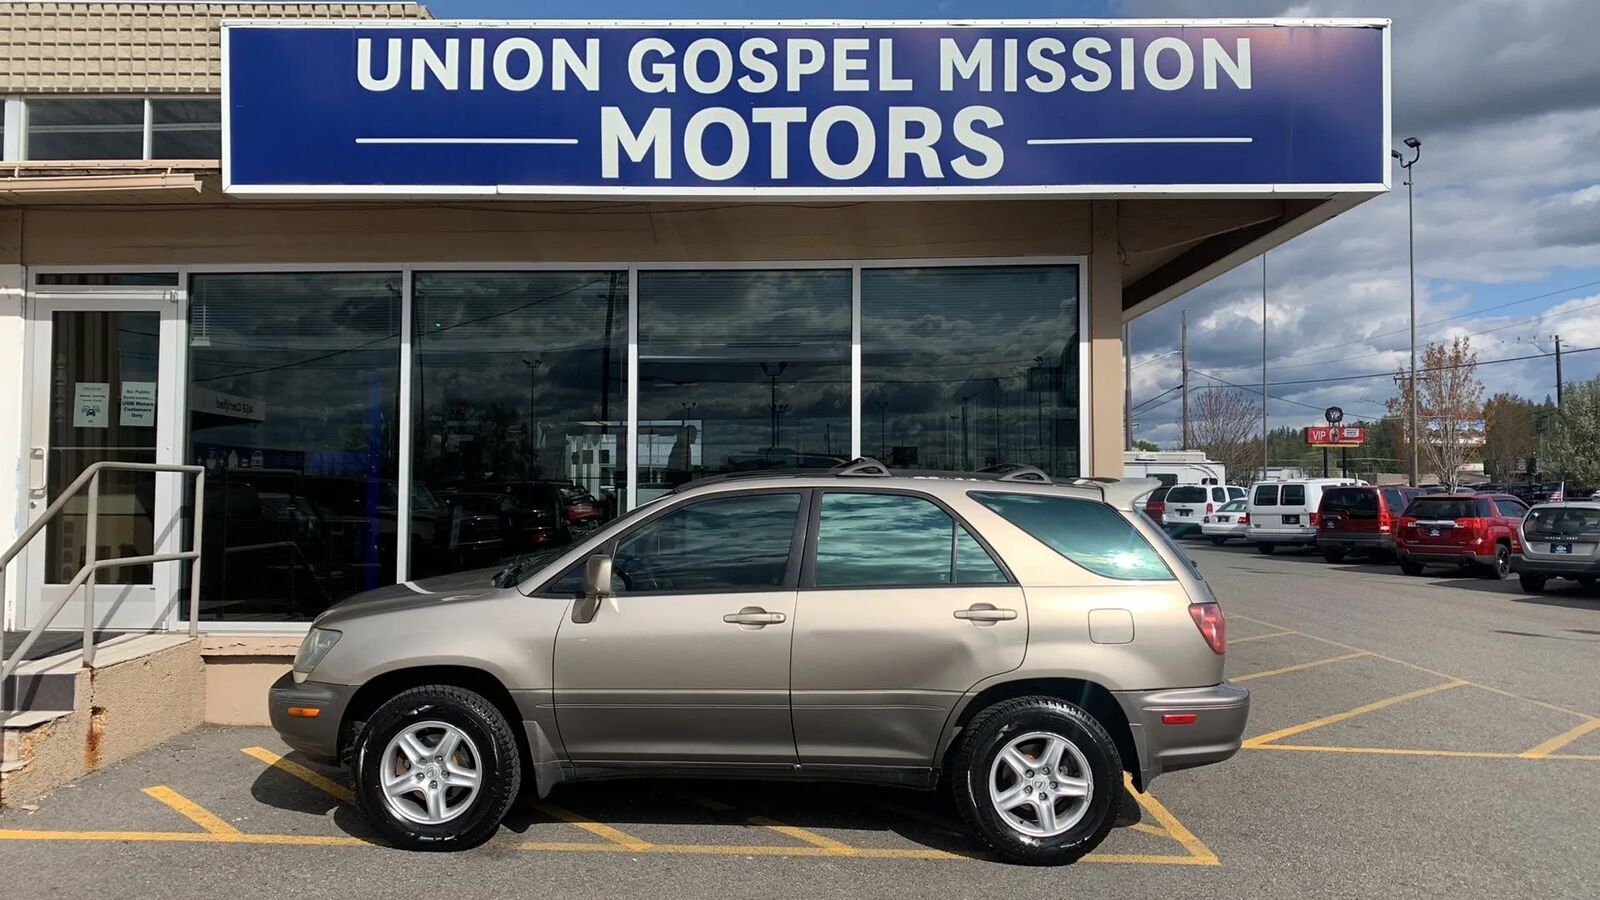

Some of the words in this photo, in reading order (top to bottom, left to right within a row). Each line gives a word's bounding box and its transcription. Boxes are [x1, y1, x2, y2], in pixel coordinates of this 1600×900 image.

[357, 37, 600, 92] UNION
[628, 37, 914, 94] GOSPEL
[940, 36, 1252, 93] MISSION
[600, 105, 1005, 182] MOTORS
[1330, 411, 1340, 419] VIP
[1312, 430, 1326, 441] VIP
